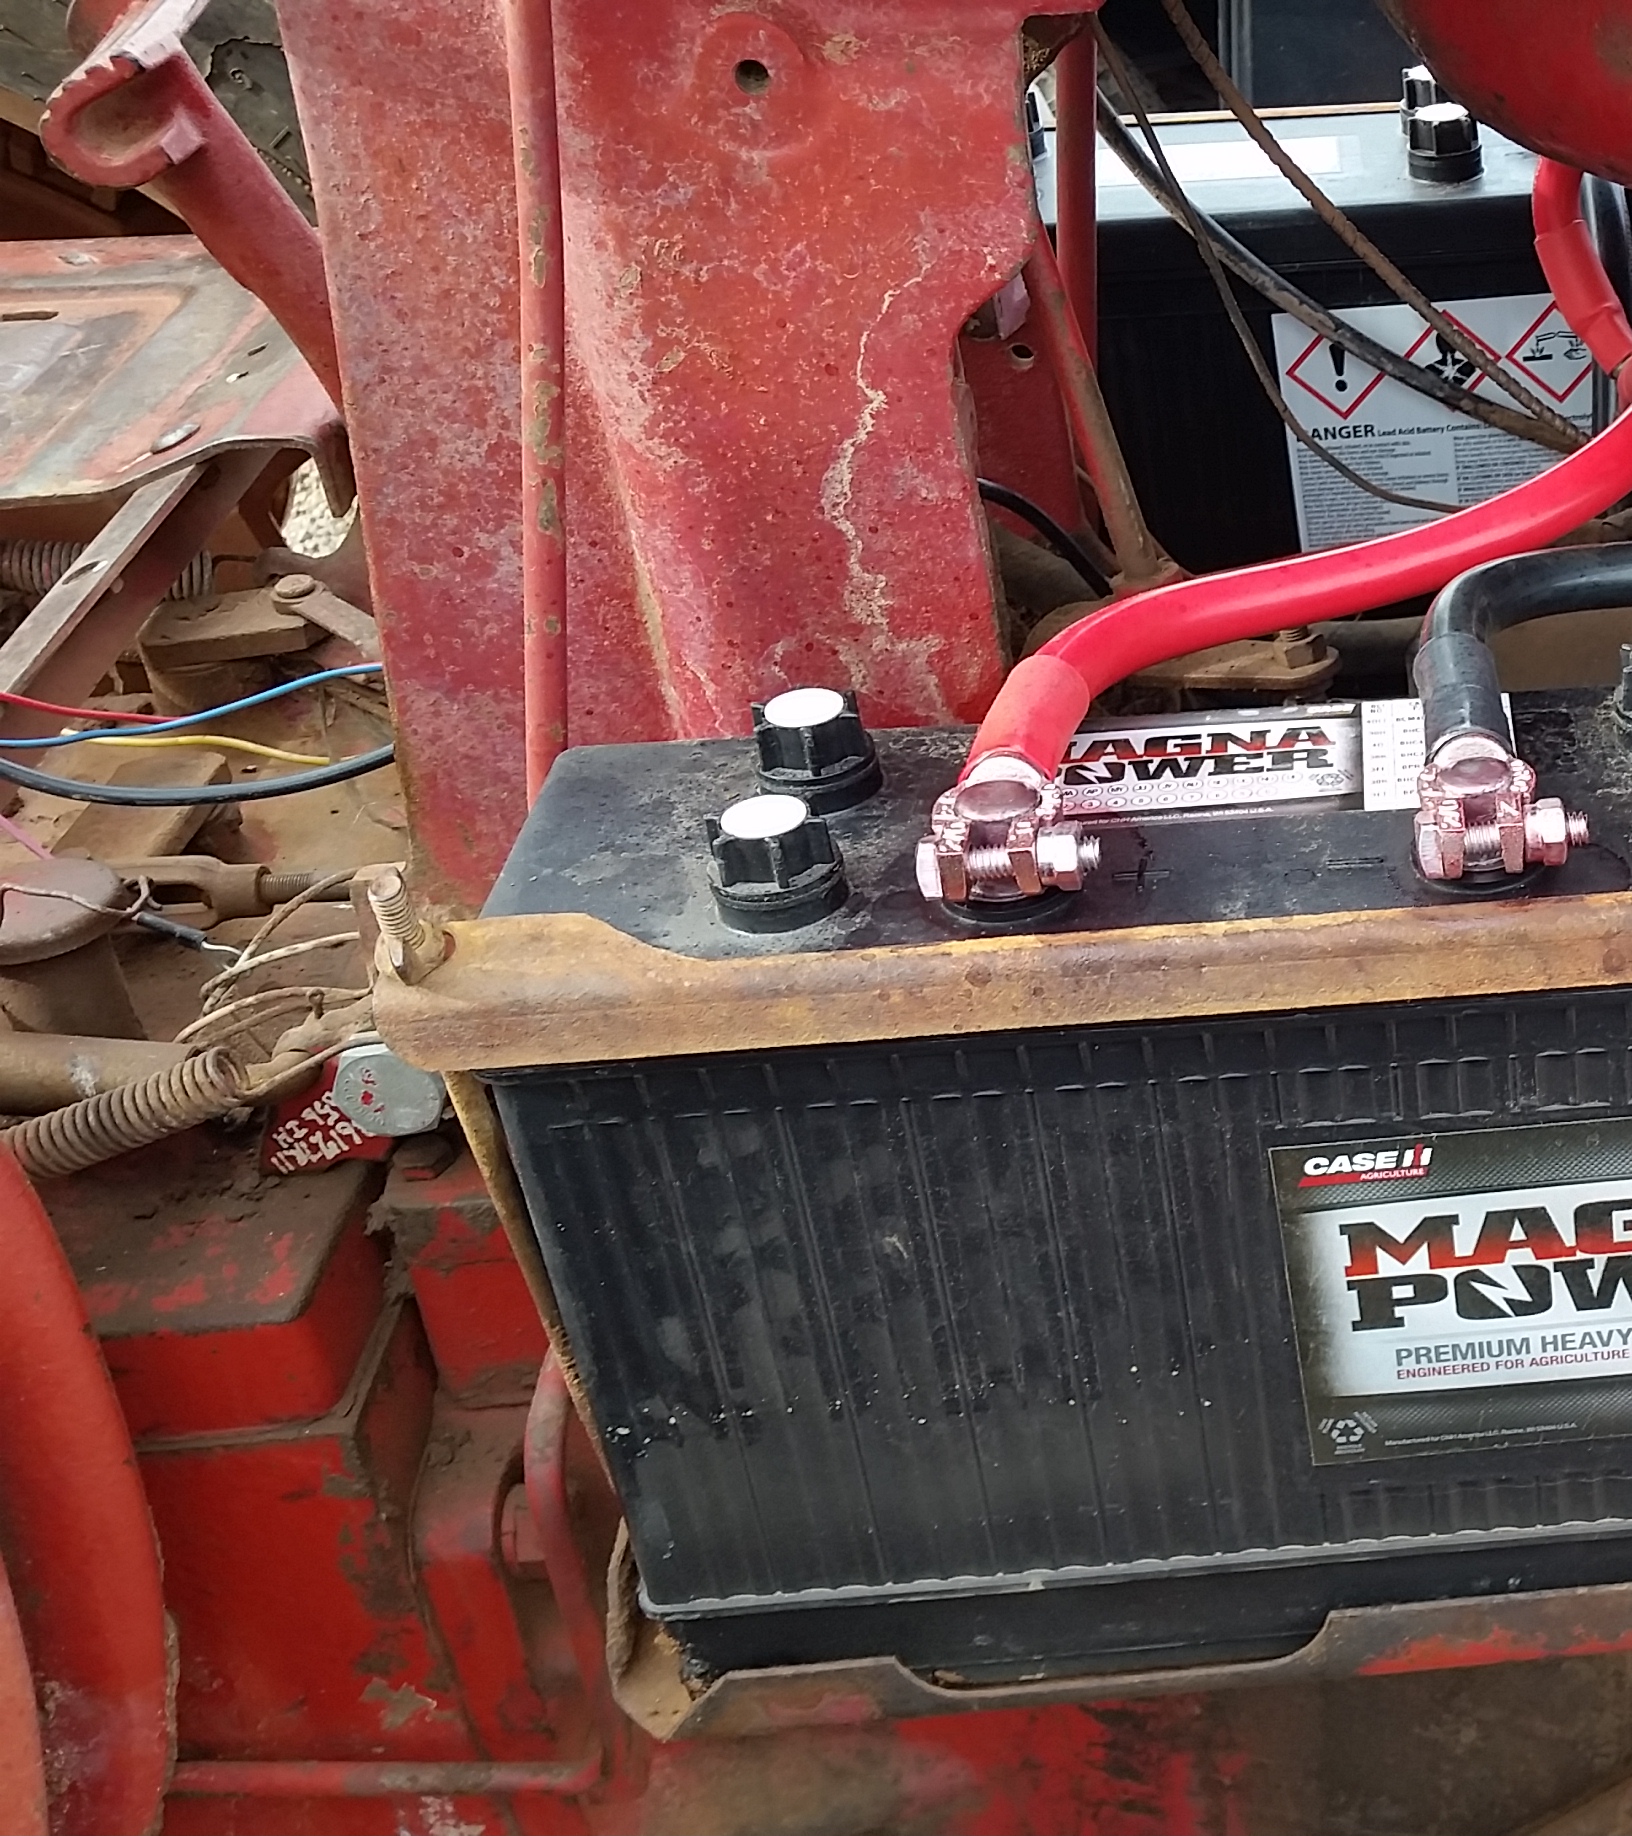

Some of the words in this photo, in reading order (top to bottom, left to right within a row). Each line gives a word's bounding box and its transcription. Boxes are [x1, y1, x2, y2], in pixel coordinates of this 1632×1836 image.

[1297, 424, 1376, 441] ANGER
[1057, 748, 1334, 786] OWER
[1303, 1149, 1399, 1176] CASE
[1359, 1167, 1426, 1181] AGRICULTURE
[1394, 1336, 1532, 1368] PREMIUM
[1396, 1361, 1491, 1381] ENGINEERED
[1494, 1358, 1526, 1371] FOR
[1528, 1347, 1630, 1368] AGRICULTURE
